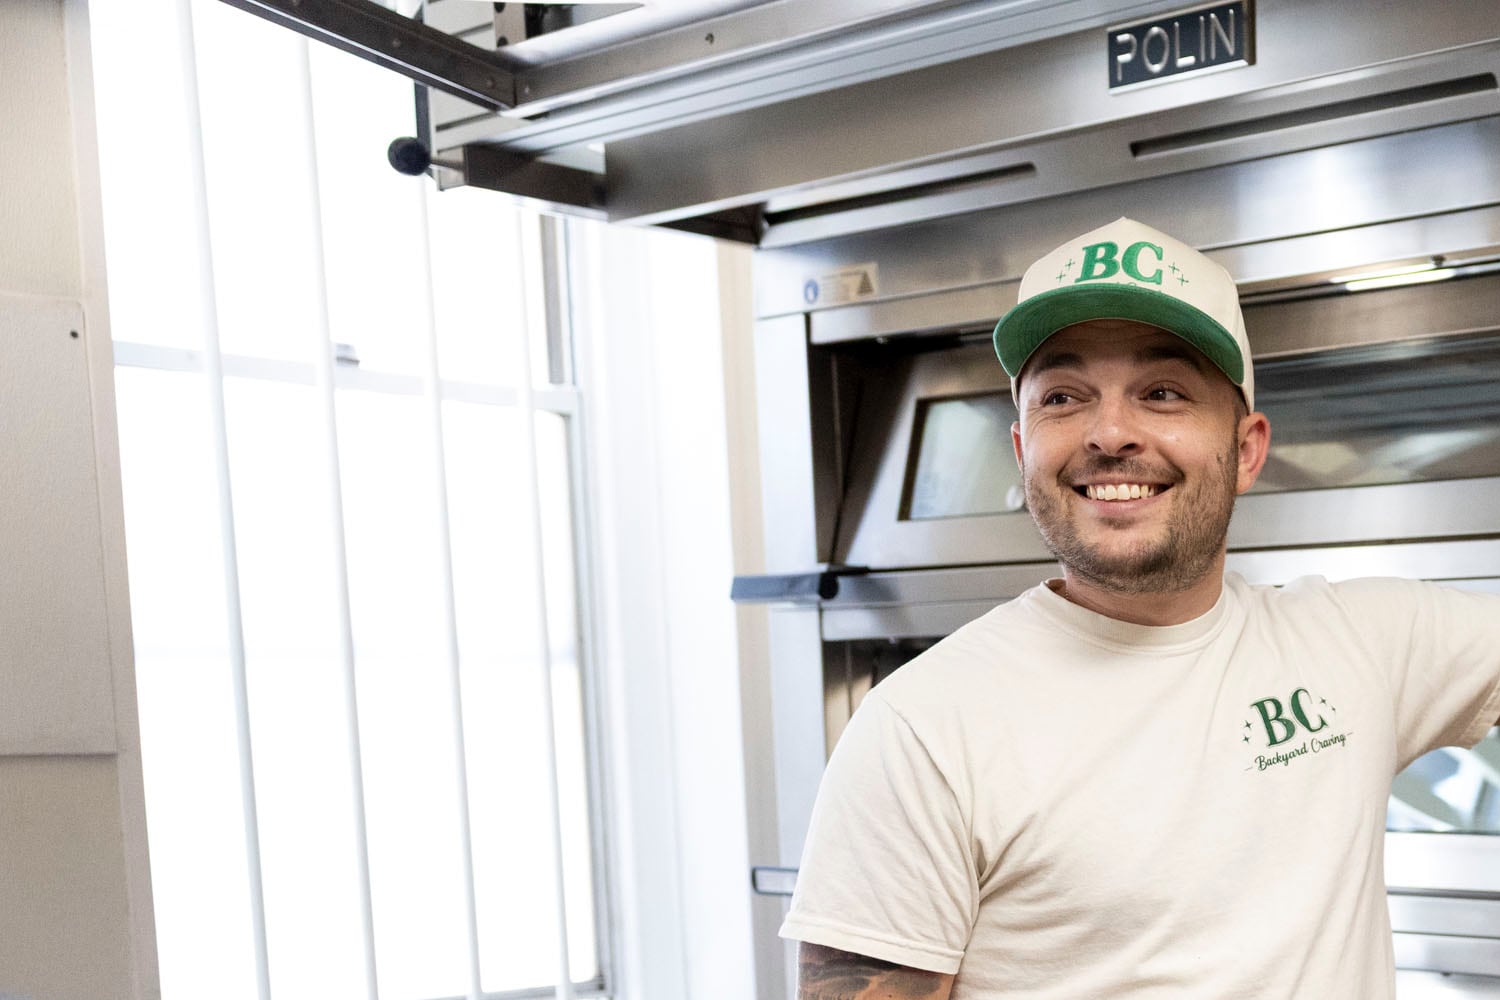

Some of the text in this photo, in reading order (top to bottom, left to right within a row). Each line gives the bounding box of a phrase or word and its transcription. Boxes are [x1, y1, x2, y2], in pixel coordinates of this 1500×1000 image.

[1116, 9, 1235, 82] POLIN
[1074, 241, 1164, 285] BC
[1250, 688, 1328, 747] BC
[1254, 734, 1346, 771] Backyard Craving
